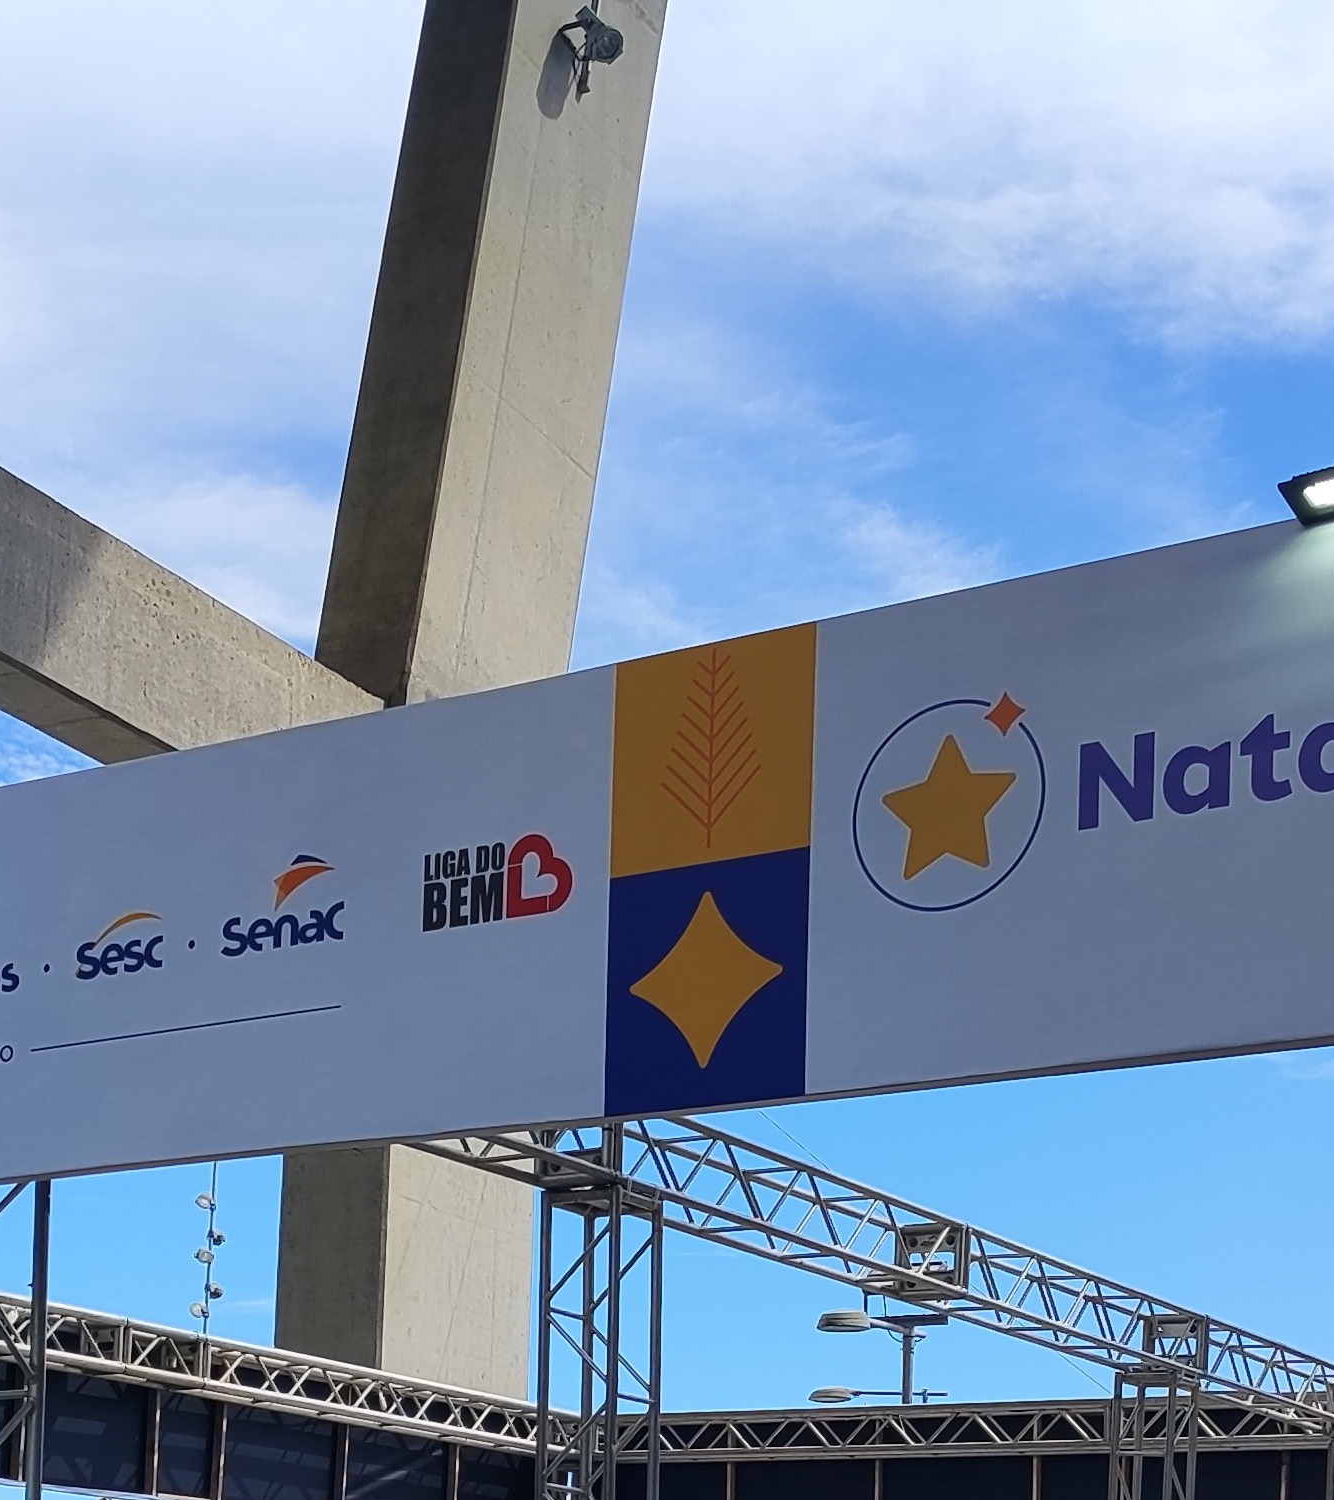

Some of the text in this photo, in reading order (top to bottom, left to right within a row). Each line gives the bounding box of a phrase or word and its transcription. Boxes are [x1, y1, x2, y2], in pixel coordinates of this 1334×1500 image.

[423, 842, 505, 882] LIGA DO
[422, 875, 504, 932] BEM
[75, 932, 163, 980] Sesc
[220, 899, 344, 958] Senac
